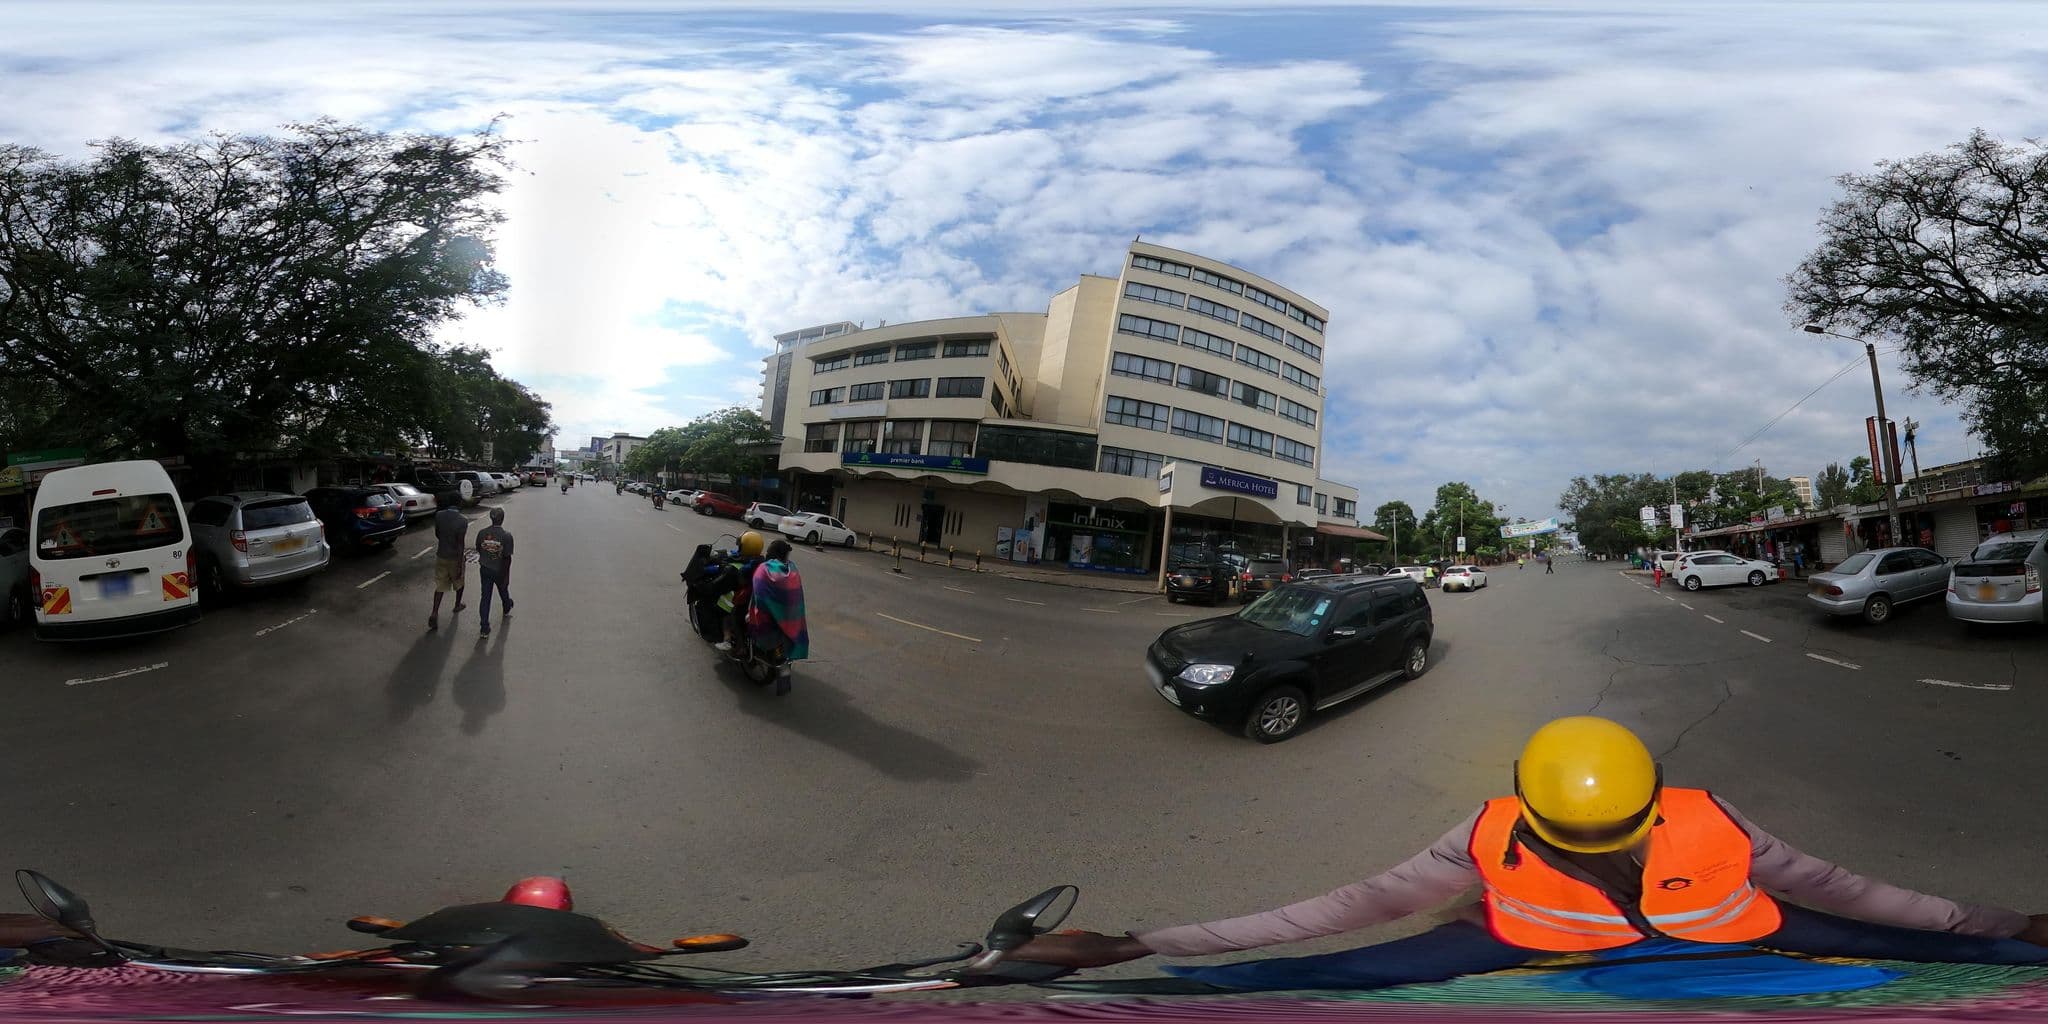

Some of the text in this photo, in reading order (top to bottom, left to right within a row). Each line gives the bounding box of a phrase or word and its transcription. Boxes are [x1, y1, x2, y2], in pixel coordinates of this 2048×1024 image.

[890, 457, 910, 465] premier
[1218, 476, 1276, 495] MERICA HOTEL
[1072, 511, 1126, 529] Infinix
[173, 551, 182, 559] 80
